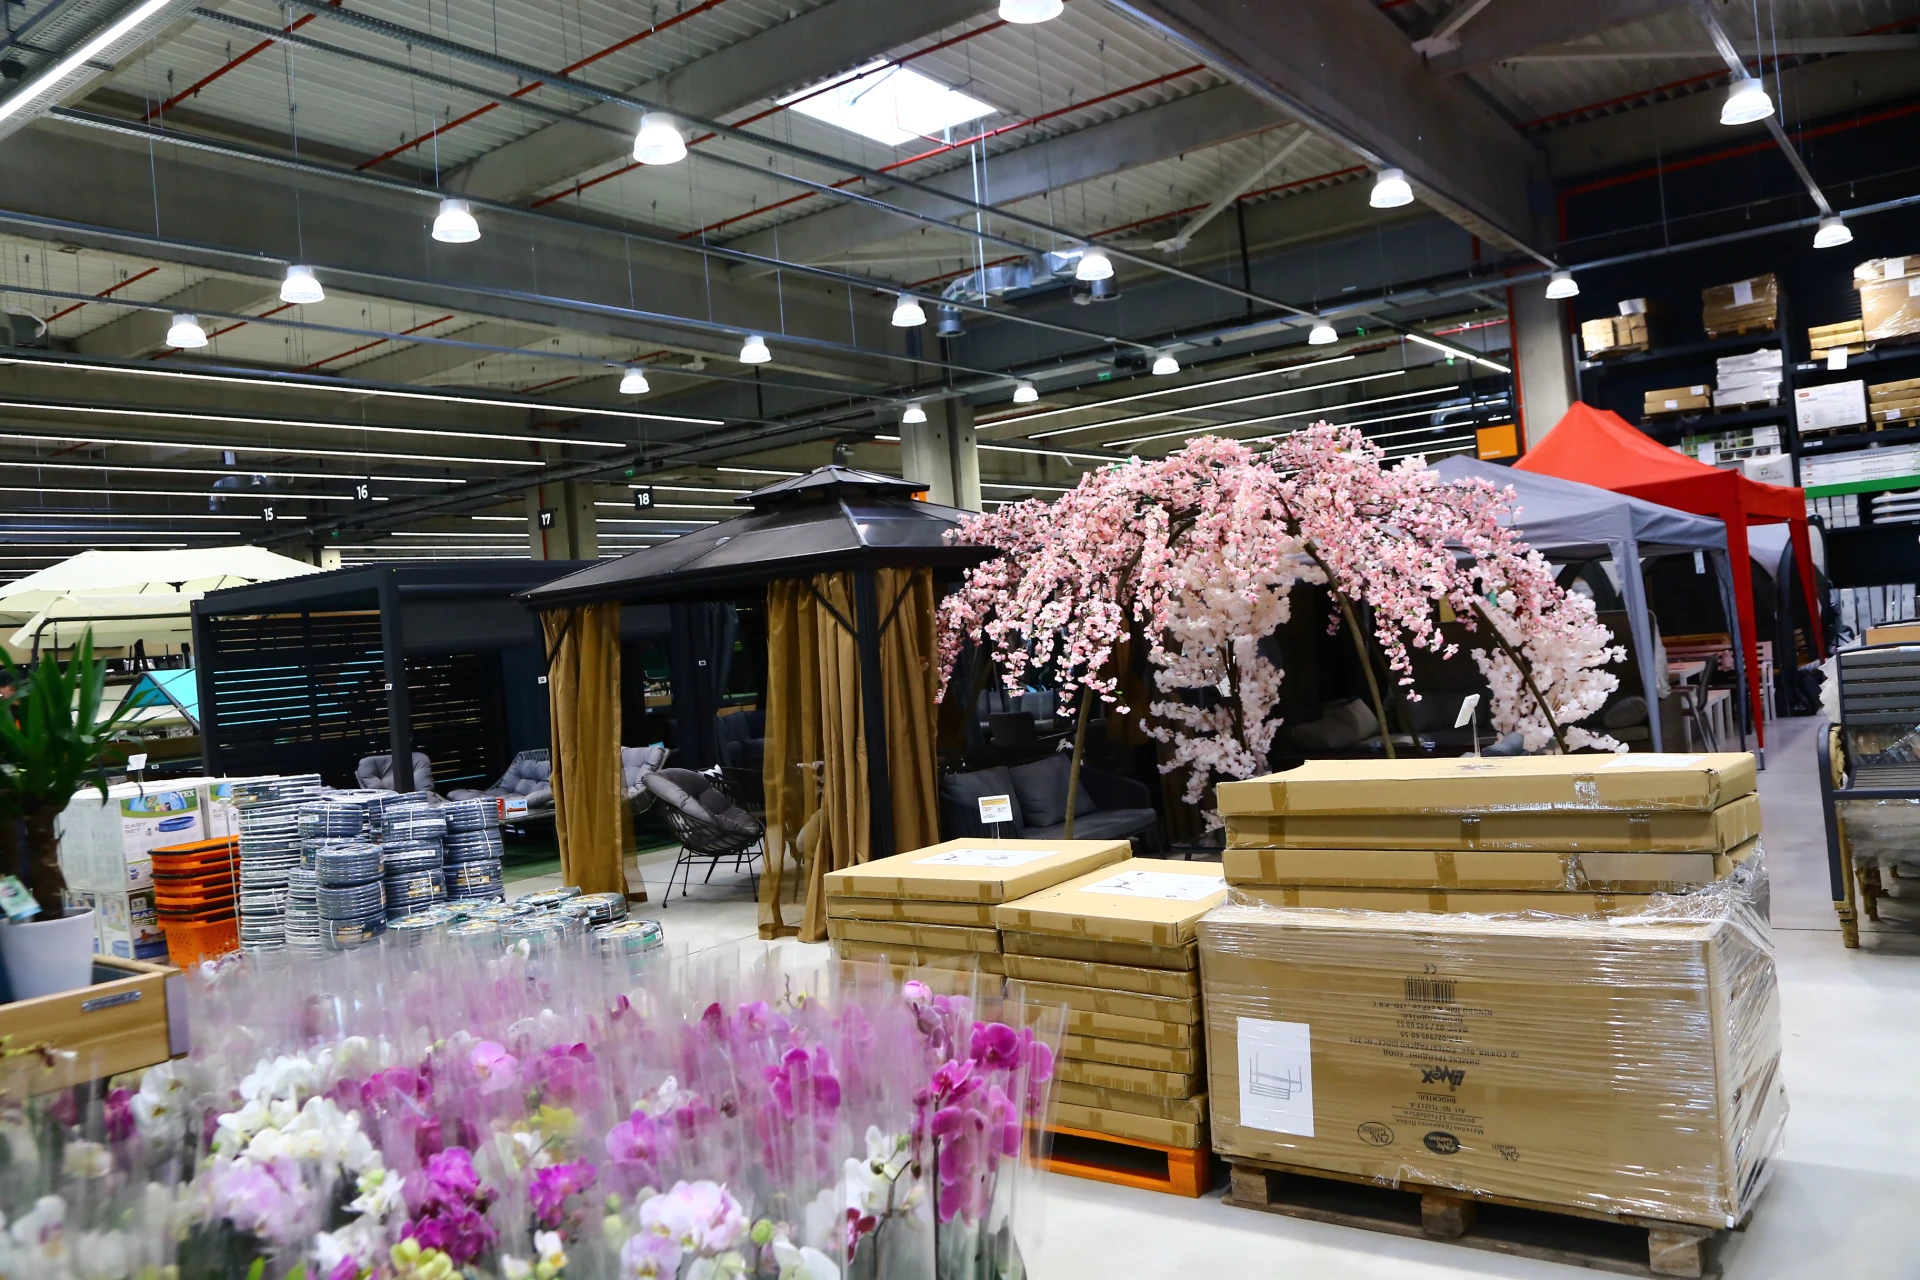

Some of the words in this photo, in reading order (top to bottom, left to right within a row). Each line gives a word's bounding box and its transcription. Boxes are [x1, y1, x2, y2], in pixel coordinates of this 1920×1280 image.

[357, 485, 368, 499] 16
[638, 493, 649, 506] 18
[264, 508, 274, 521] 15
[542, 513, 551, 525] 17
[169, 790, 195, 800] INTEX
[124, 822, 147, 830] EASY
[132, 911, 155, 921] EAS
[133, 919, 155, 927] SET
[1462, 1008, 1493, 1016] NINGBO
[1383, 1049, 1403, 1057] ЕООД
[1418, 1095, 1456, 1104] ВНОСИТЕЛ:
[1448, 1116, 1476, 1124] размер:
[1418, 1121, 1453, 1131] Градинска
[1454, 1126, 1484, 1135] Метална
[1362, 1126, 1386, 1136] Garden
[1428, 1136, 1453, 1145] Garden
[1492, 1144, 1517, 1153] Garden
